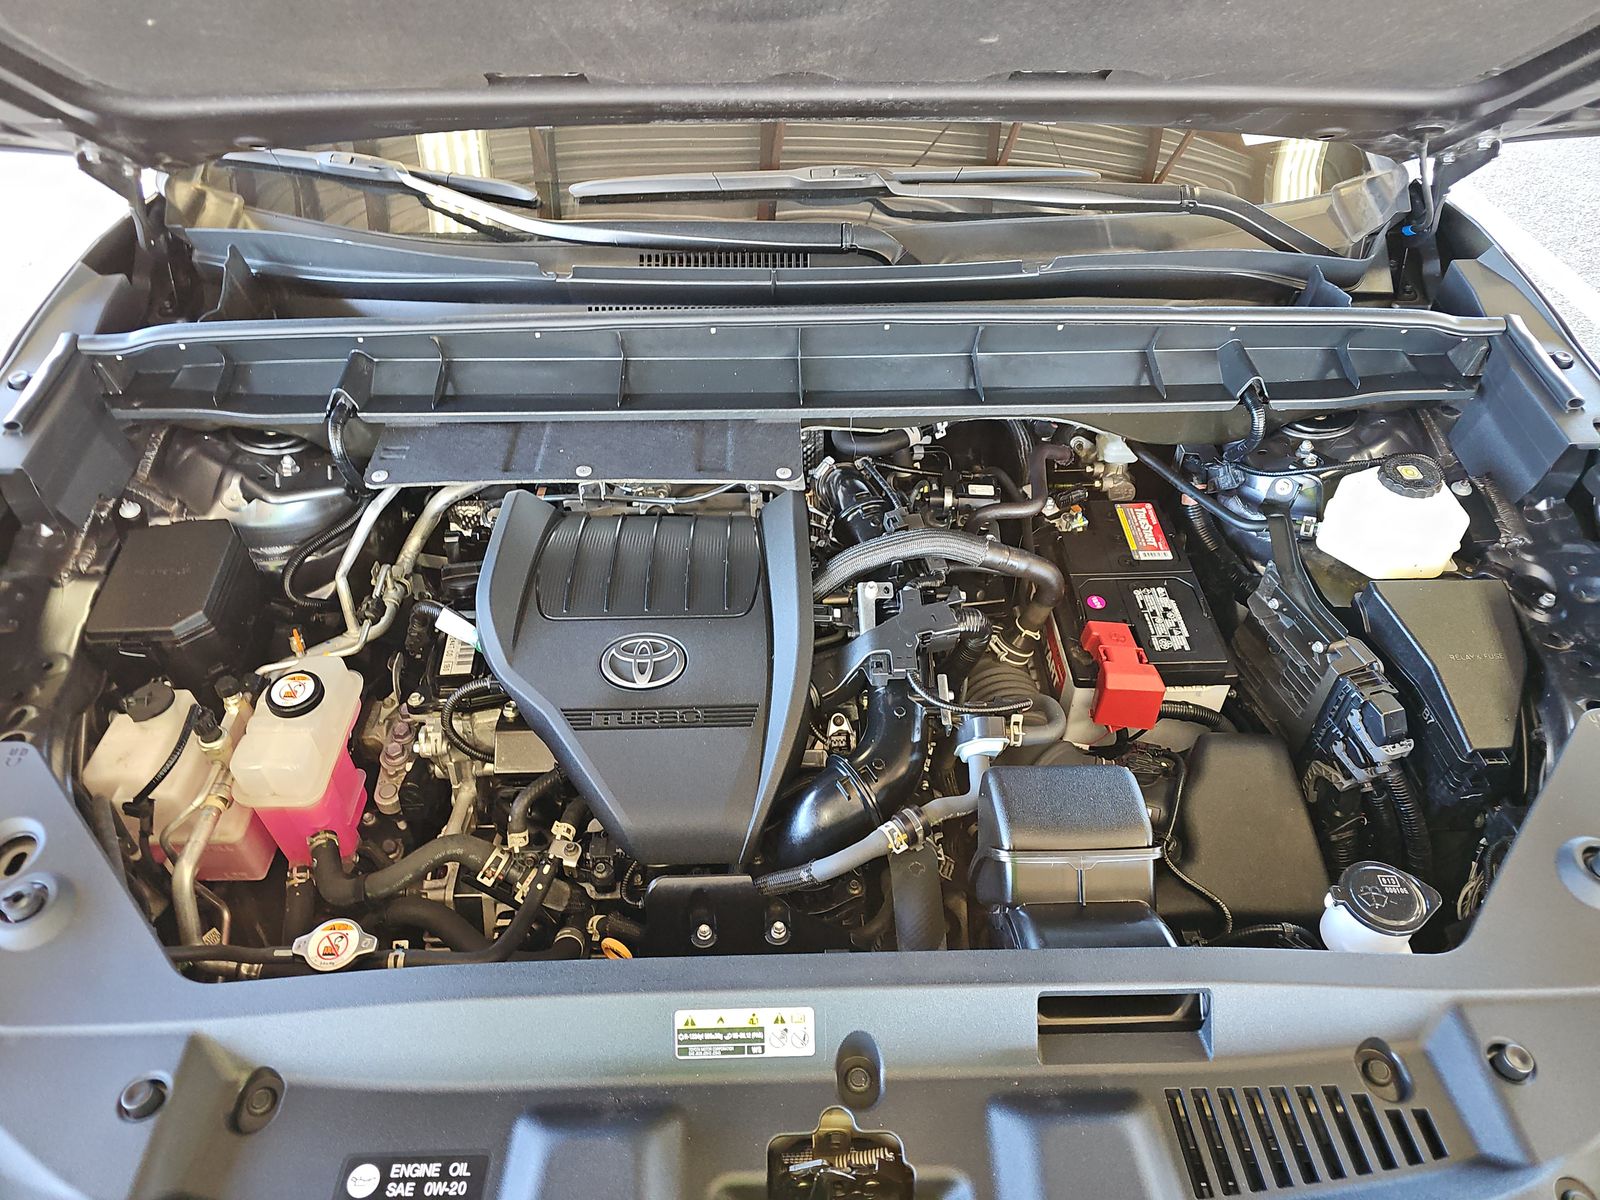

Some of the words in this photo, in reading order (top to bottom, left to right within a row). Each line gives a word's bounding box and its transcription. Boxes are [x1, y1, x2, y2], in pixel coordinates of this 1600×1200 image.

[1449, 653, 1475, 661] RELAY
[1484, 652, 1505, 660] FUSE
[593, 709, 702, 726] TURBO
[390, 1162, 442, 1178] ENGINE
[448, 1162, 471, 1177] OIL
[385, 1181, 416, 1197] SAE
[423, 1181, 467, 1196] 0W-20
